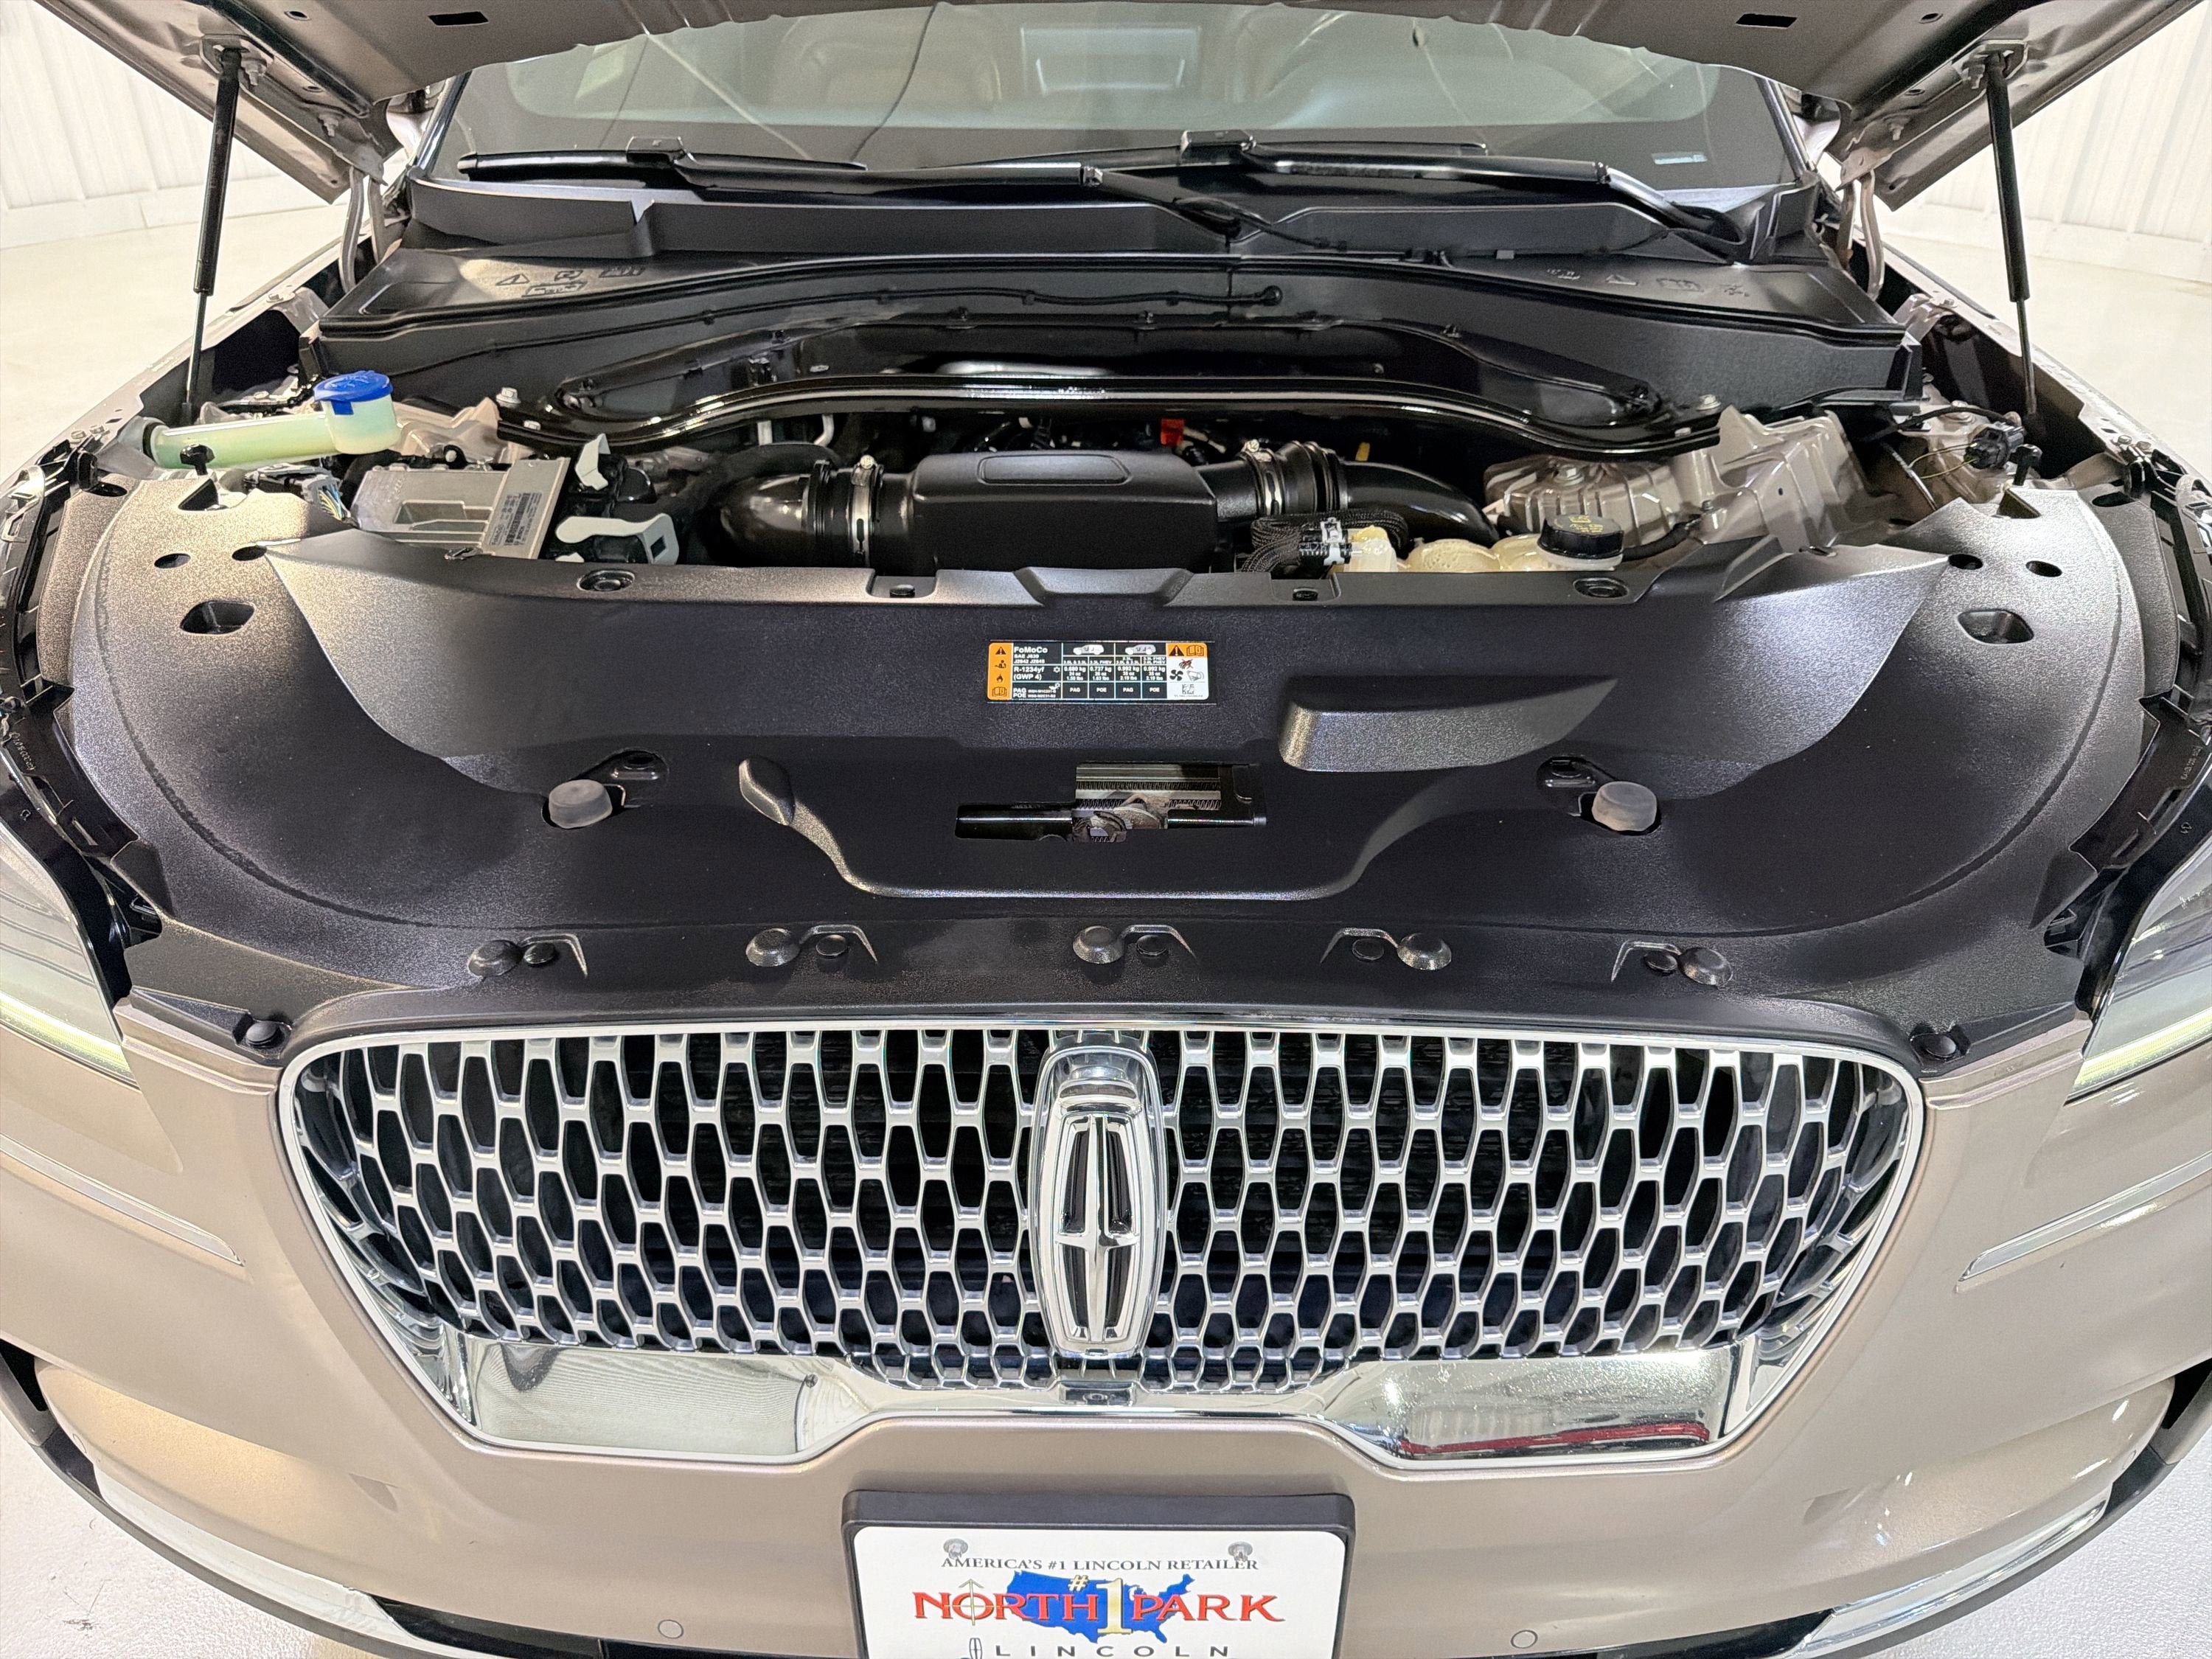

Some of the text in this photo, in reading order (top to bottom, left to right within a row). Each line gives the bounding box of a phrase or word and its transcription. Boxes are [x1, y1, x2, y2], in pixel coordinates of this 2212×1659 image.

[941, 1557, 1259, 1571] AMERICA'S #1 LINCOLN RETAILER
[912, 1591, 1099, 1621] NORTH
[1130, 1593, 1286, 1622] PARK
[995, 1644, 1229, 1658] LINCOLN
